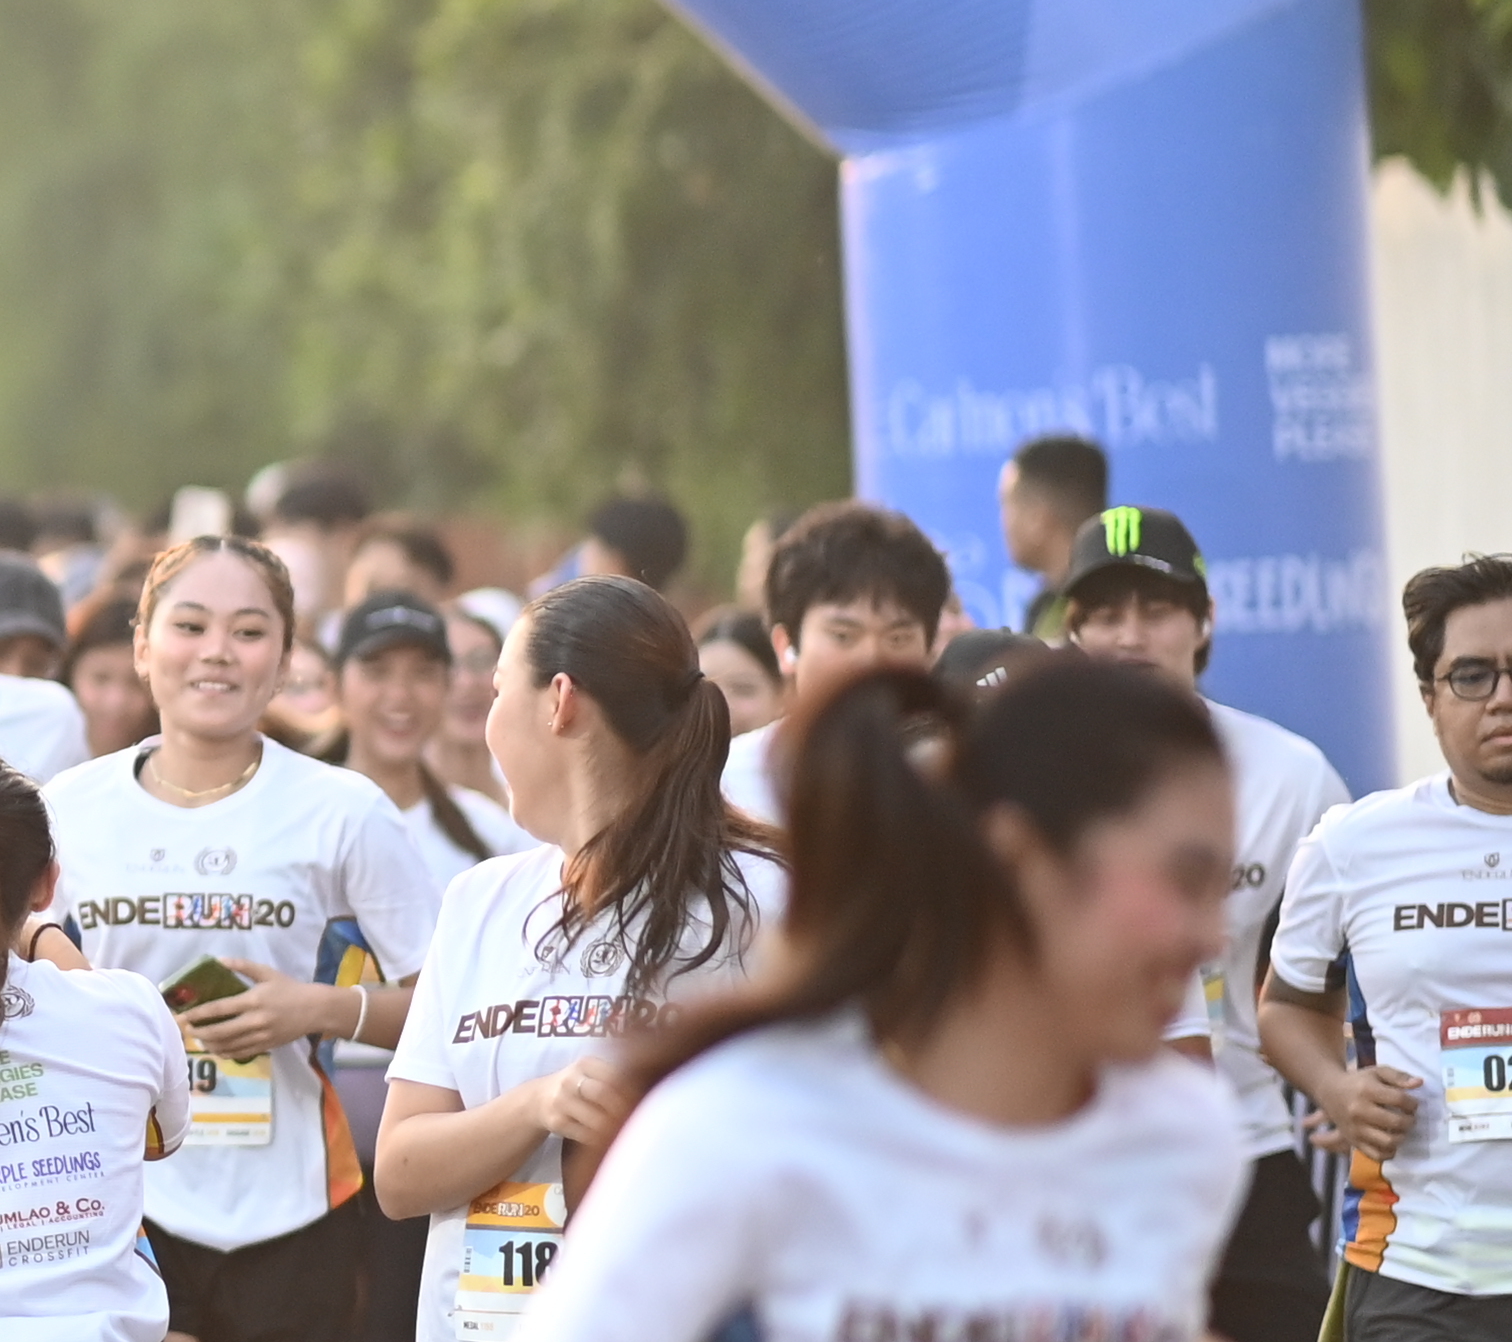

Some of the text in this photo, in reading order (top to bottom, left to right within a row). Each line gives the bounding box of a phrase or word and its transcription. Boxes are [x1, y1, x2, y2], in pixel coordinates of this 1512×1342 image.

[1393, 897, 1512, 932] ENDE
[39, 1102, 97, 1139] Best
[32, 1151, 102, 1178] SEEDLINGS
[66, 1171, 106, 1183] CENTER
[48, 1210, 104, 1224] ACCOUNTING
[56, 1200, 71, 1216] &
[7, 1229, 90, 1256] ENDERUN
[8, 1245, 90, 1268] CROSSFIT
